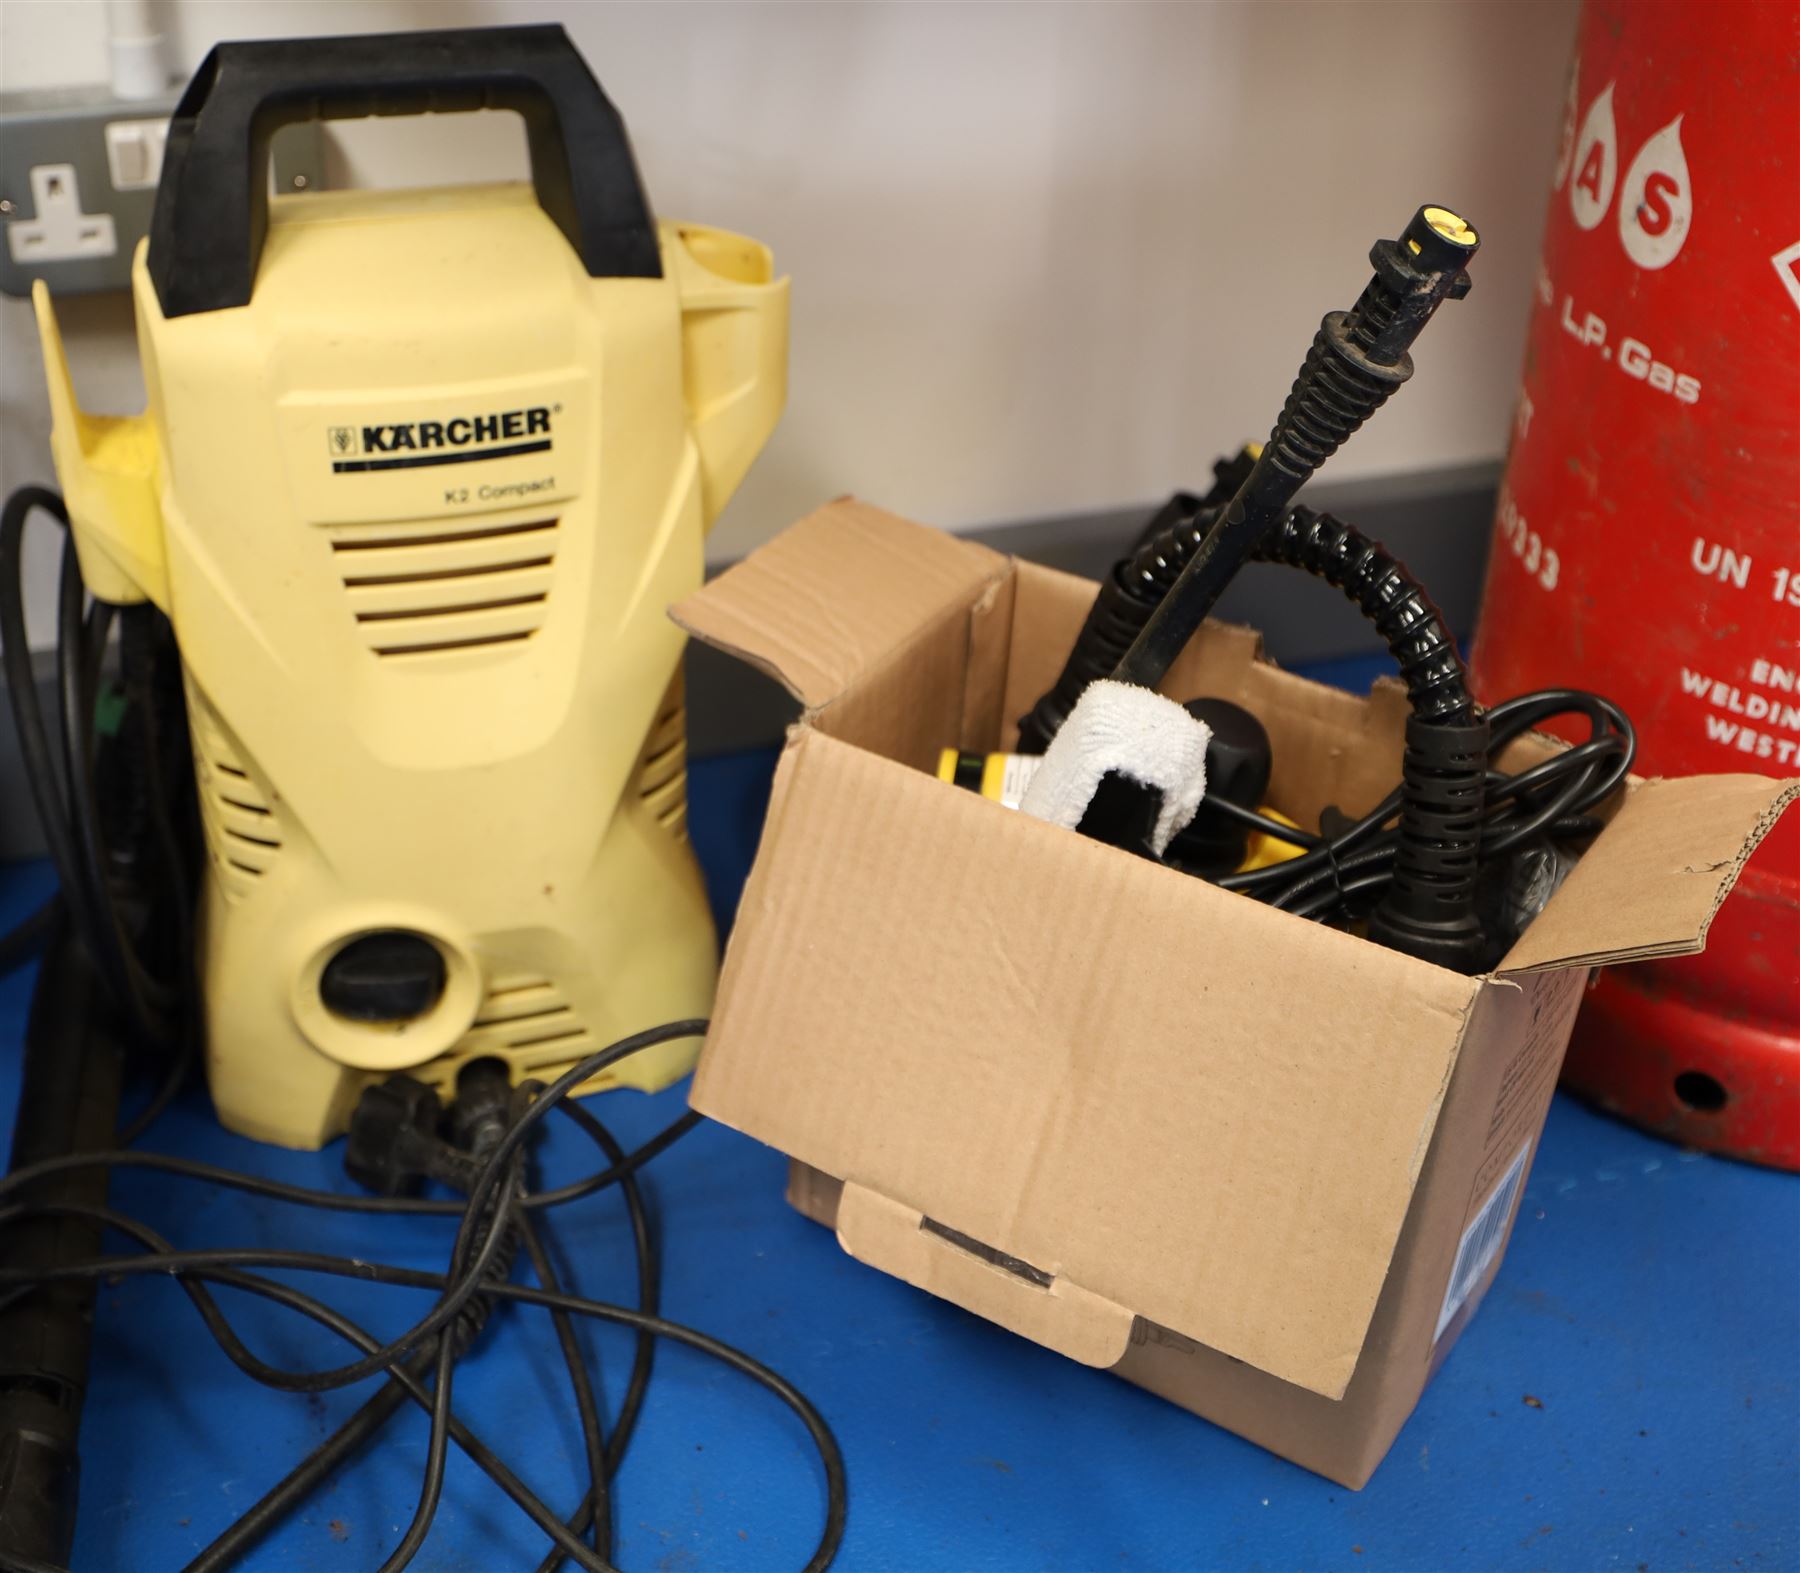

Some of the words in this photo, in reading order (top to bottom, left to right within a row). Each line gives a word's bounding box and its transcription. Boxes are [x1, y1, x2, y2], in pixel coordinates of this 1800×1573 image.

[1618, 336, 1701, 405] Gas
[362, 407, 552, 453] KÄRCHER
[443, 489, 470, 505] K2
[478, 476, 556, 501] Compact
[1691, 536, 1751, 589] UN
[1750, 656, 1800, 694] EN
